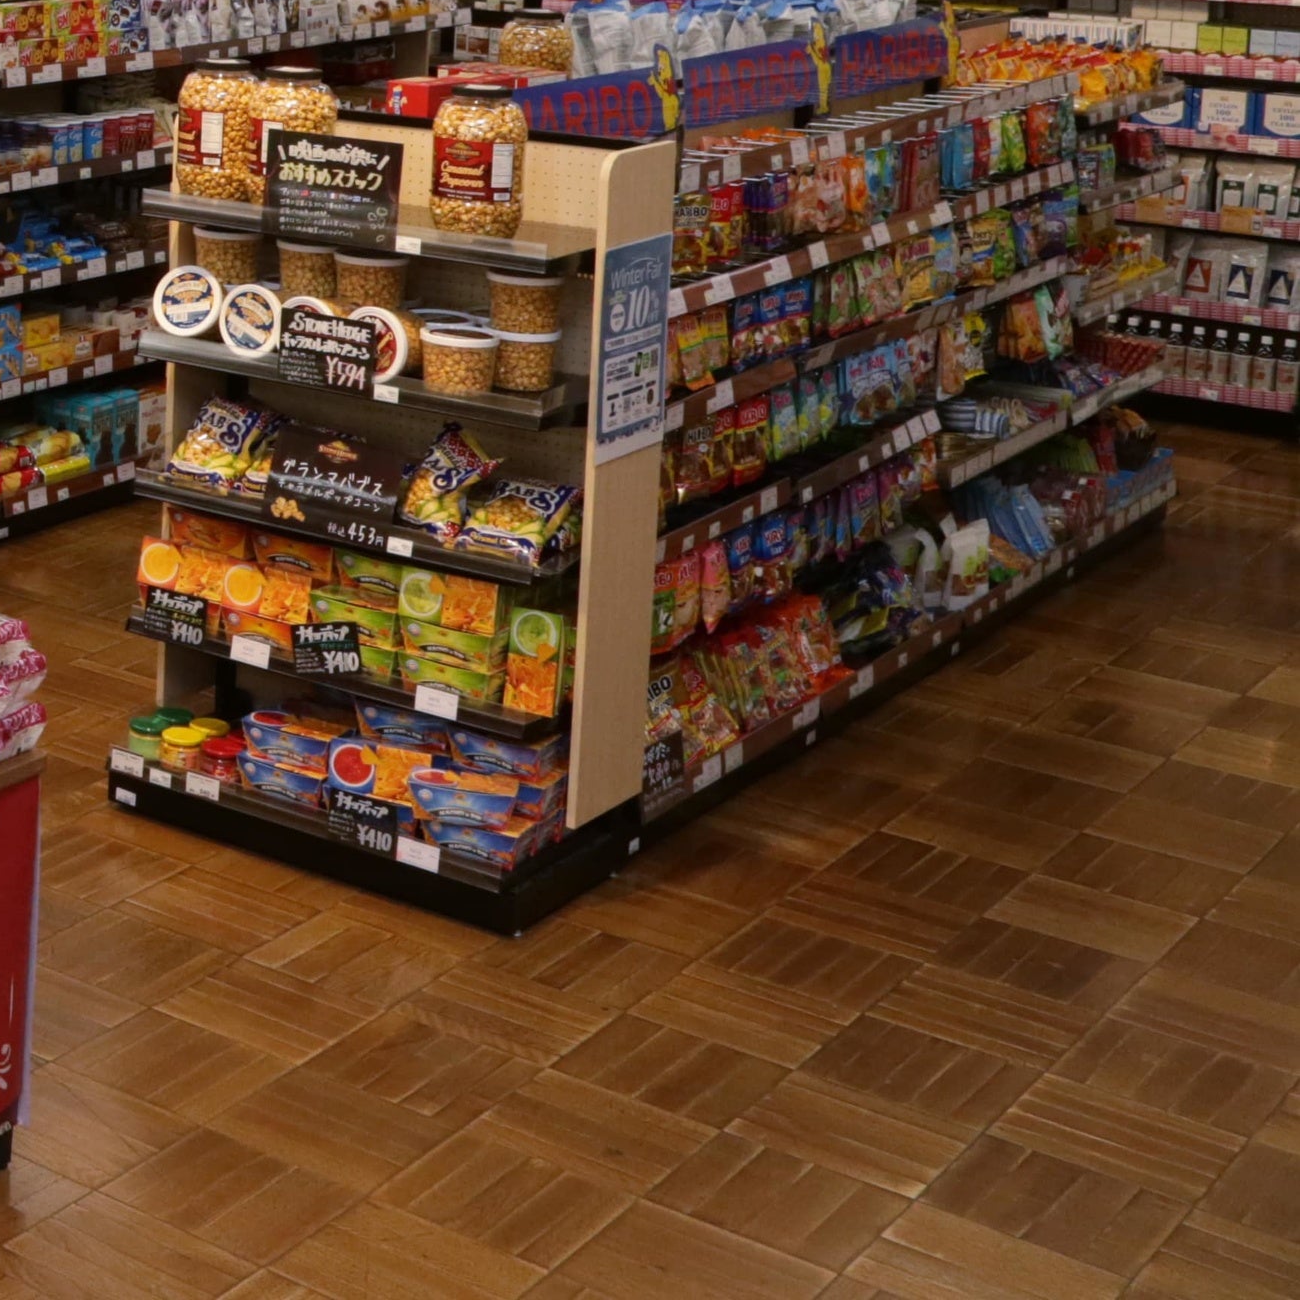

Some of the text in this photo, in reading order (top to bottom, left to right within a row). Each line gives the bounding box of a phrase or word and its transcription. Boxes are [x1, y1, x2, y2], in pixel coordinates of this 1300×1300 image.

[840, 25, 941, 94] HARIBO
[688, 49, 812, 125] HARIBO
[289, 138, 378, 167] 映画のお供に
[278, 162, 383, 192] おすすめスナック
[610, 259, 663, 290] Winter Fair
[281, 332, 371, 360] キャラメルポップコーン
[325, 355, 367, 390] ¥594
[171, 621, 203, 645] ¥410
[323, 650, 360, 674] ¥410
[356, 822, 392, 852] ¥410
